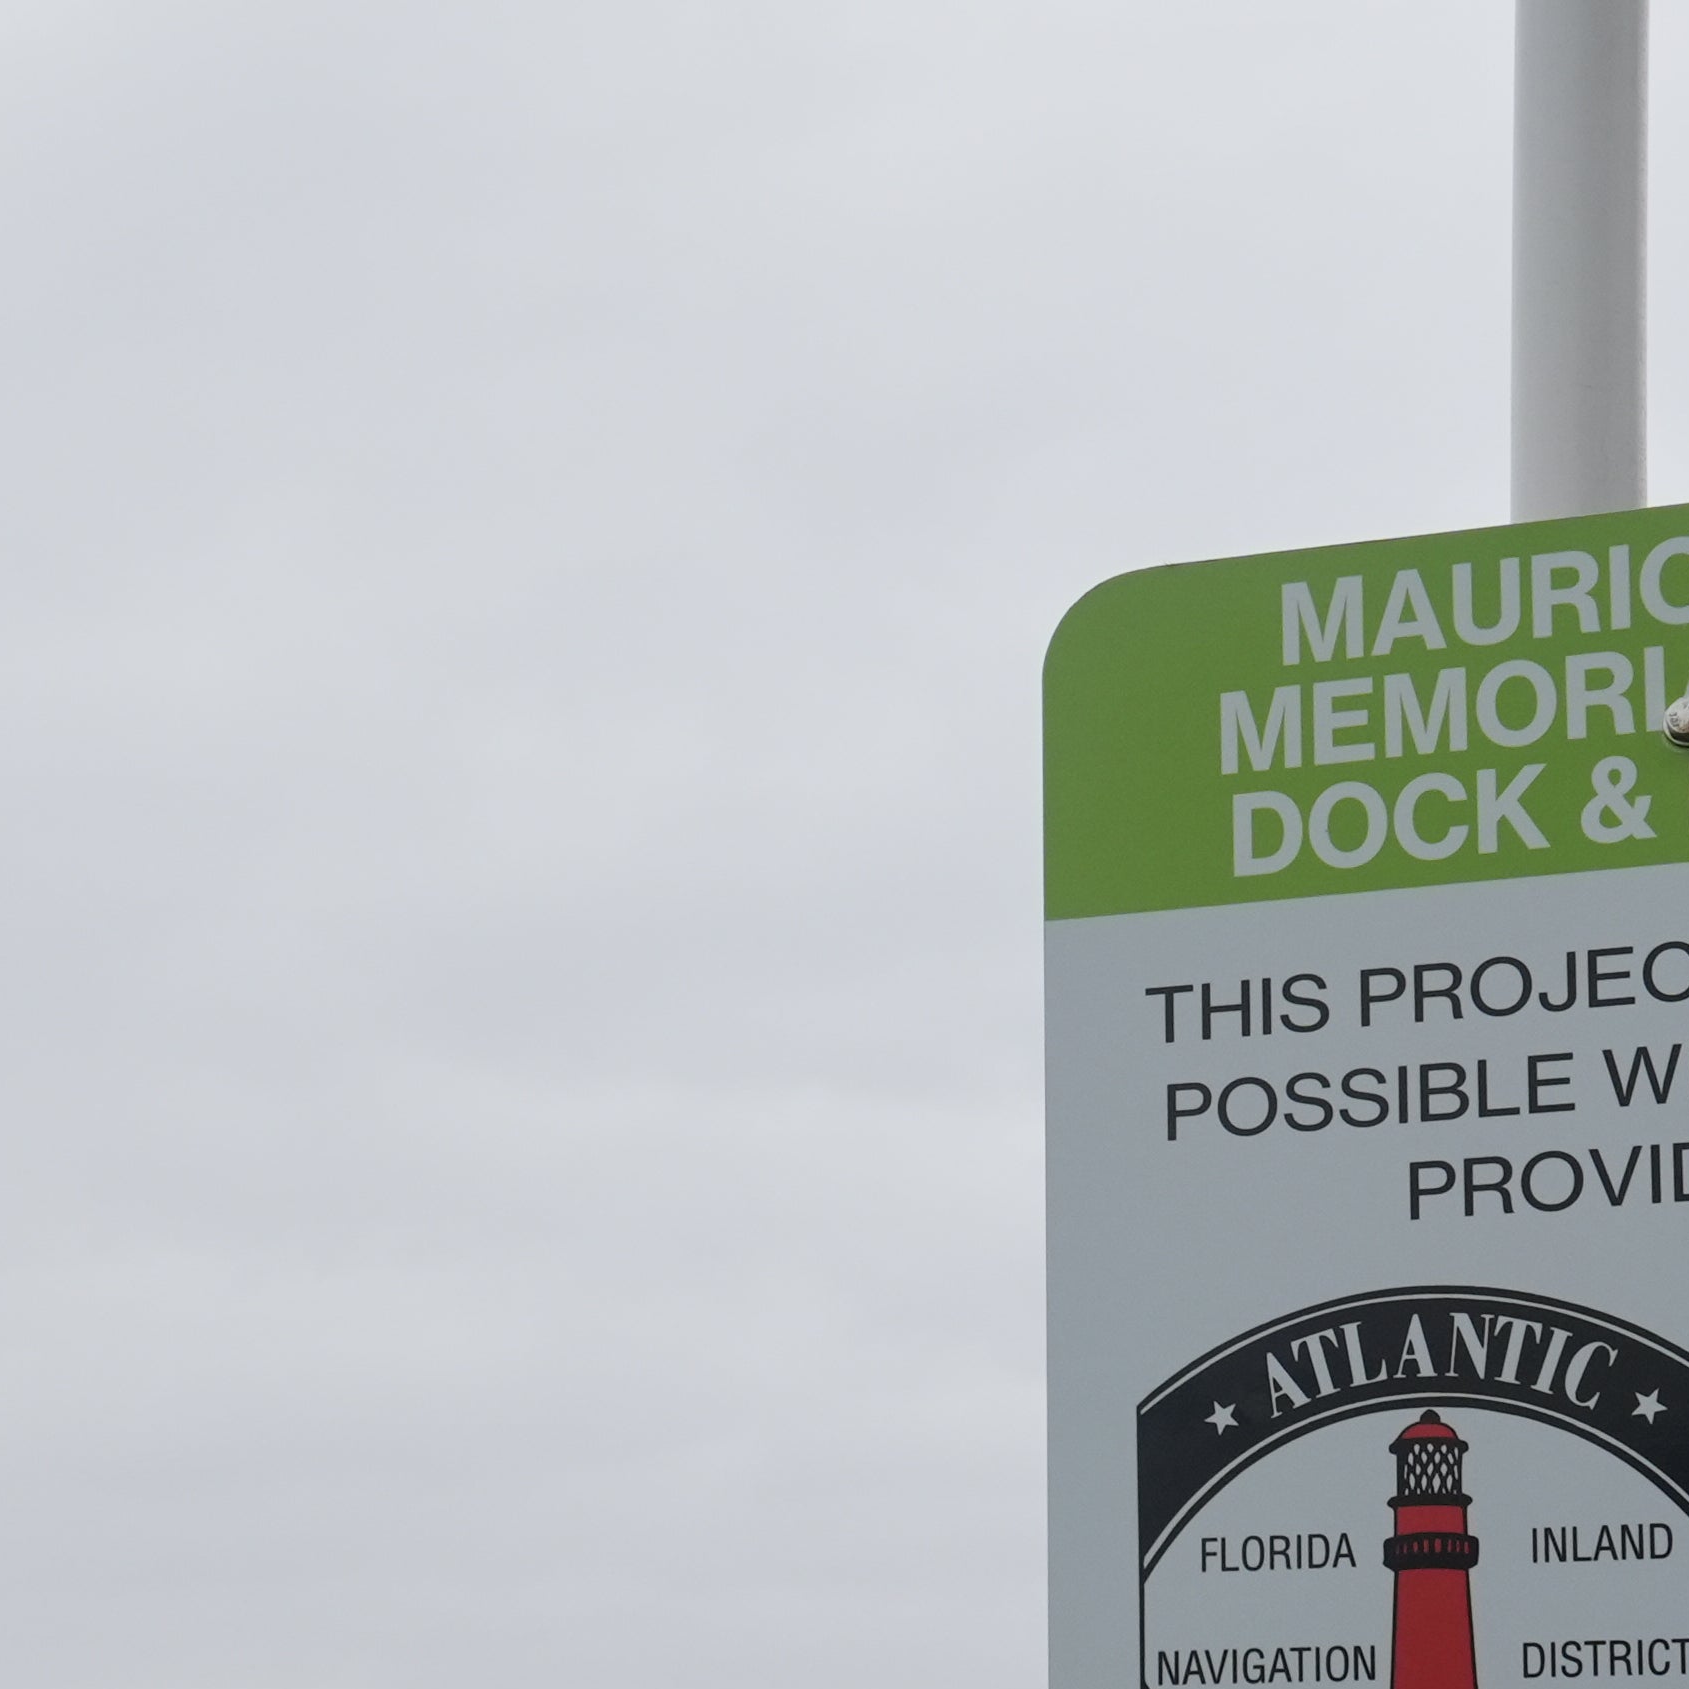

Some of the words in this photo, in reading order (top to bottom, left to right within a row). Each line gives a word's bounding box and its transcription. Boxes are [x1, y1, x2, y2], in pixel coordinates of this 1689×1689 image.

[1231, 762, 1552, 878] DOCK
[1579, 754, 1658, 845] &
[1144, 972, 1331, 1045] THIS
[1165, 1051, 1577, 1143] POSSIBLE
[1265, 1311, 1619, 1420] ATLANTIC
[1199, 1531, 1358, 1574] FLORIDA
[1531, 1521, 1674, 1565] INLAND
[1156, 1643, 1377, 1687] NAVIGATION
